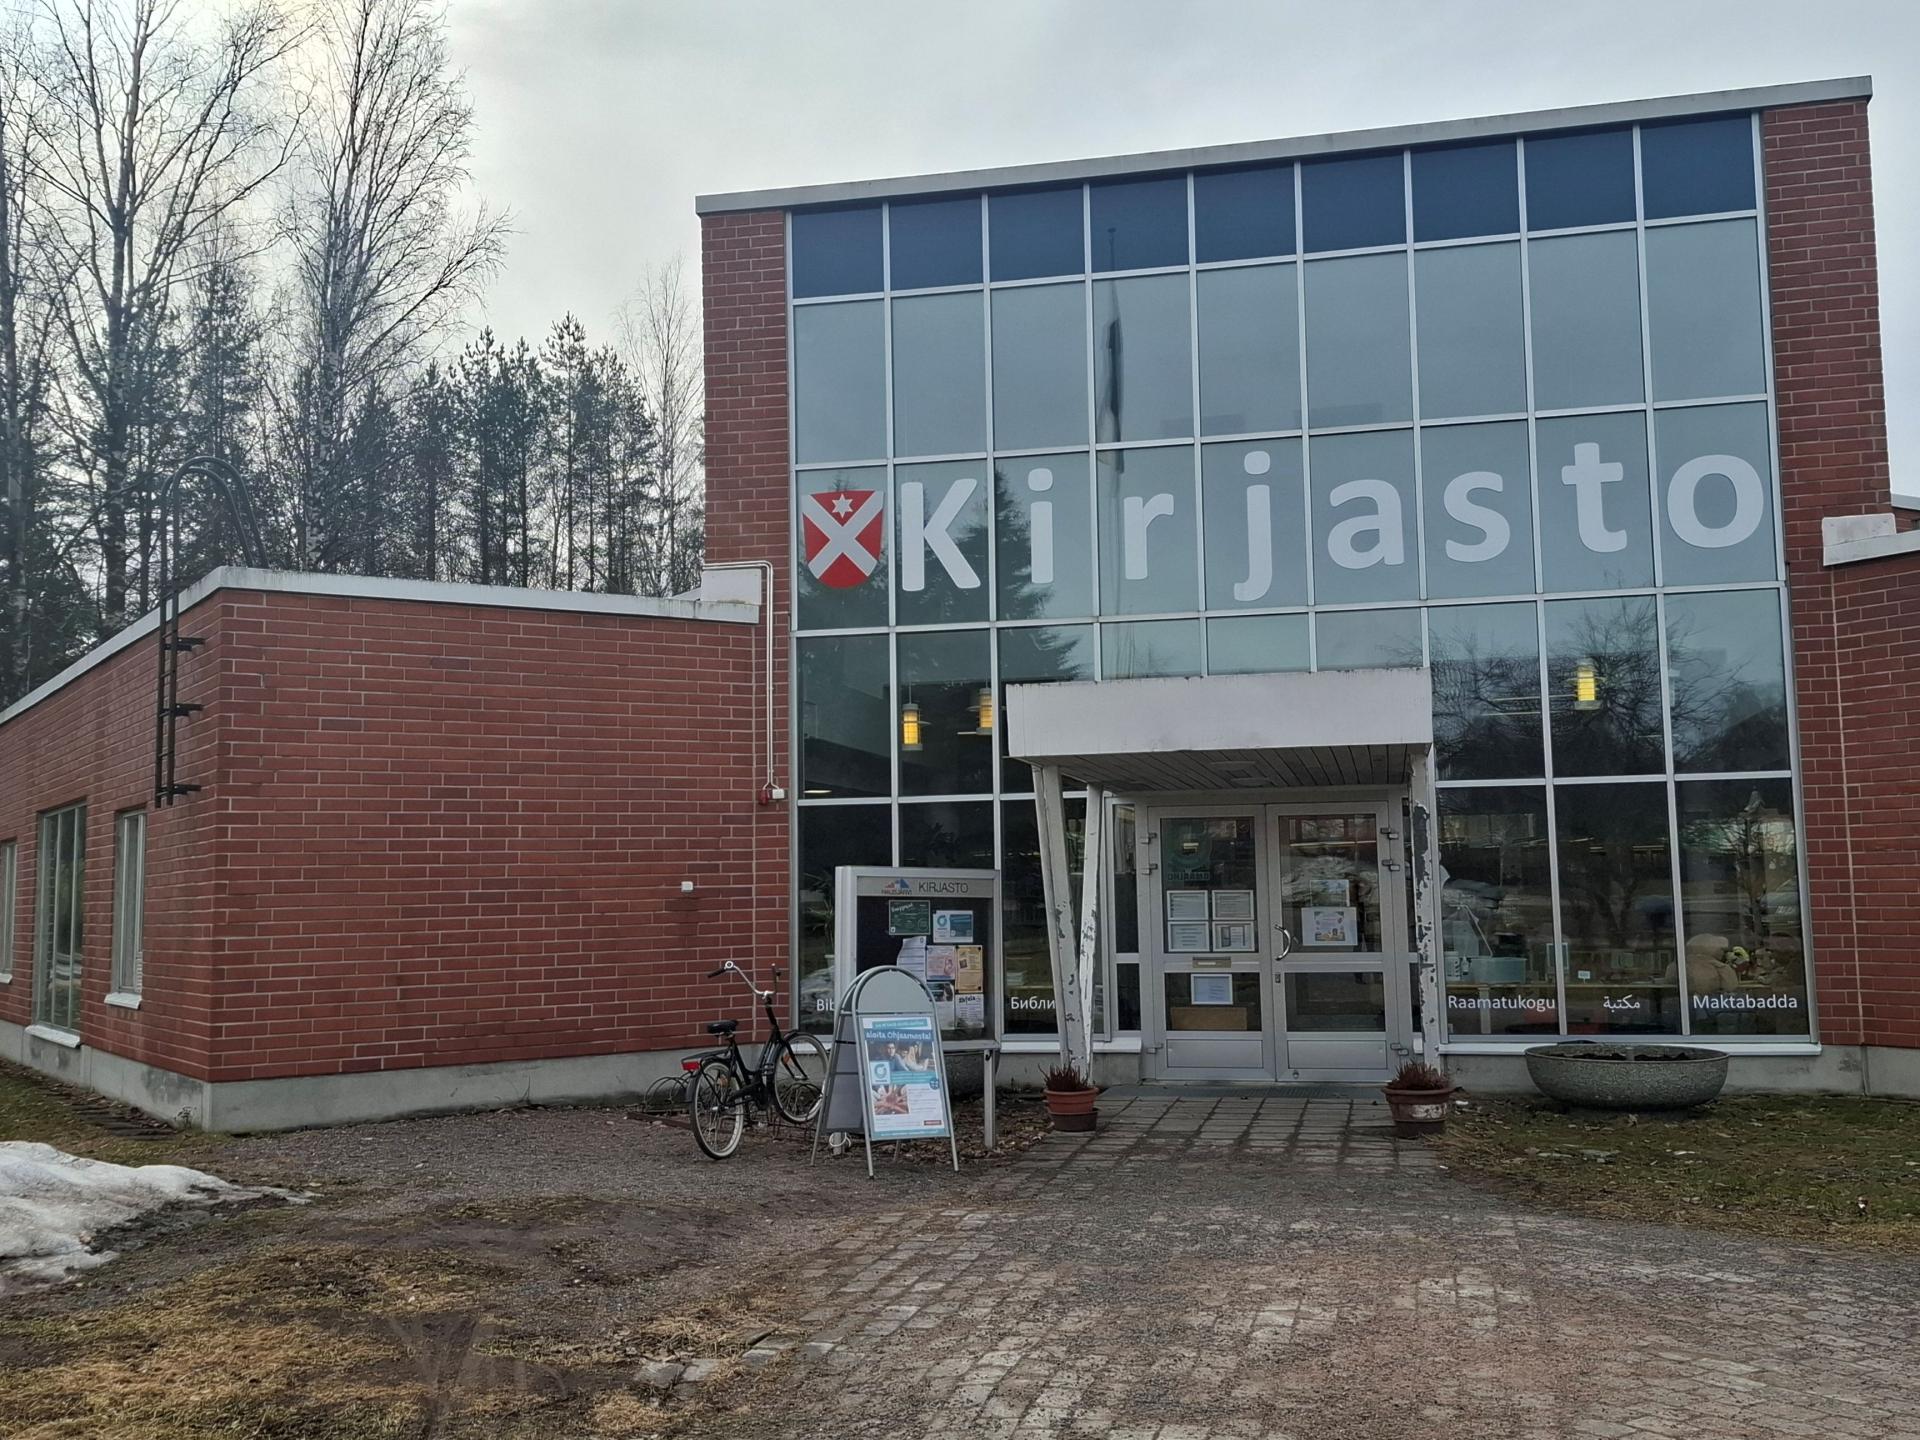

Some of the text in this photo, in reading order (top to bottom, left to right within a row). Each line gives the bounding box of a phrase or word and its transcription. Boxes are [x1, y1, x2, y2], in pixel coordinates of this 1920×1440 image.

[902, 441, 1764, 602] Kirjasto
[918, 881, 969, 894] KIRJASTO
[1010, 996, 1056, 1010] Библи
[1448, 995, 1556, 1012] Raamatukogu
[1603, 994, 1641, 1013] مكتبة
[1693, 994, 1798, 1009] Maktabadda
